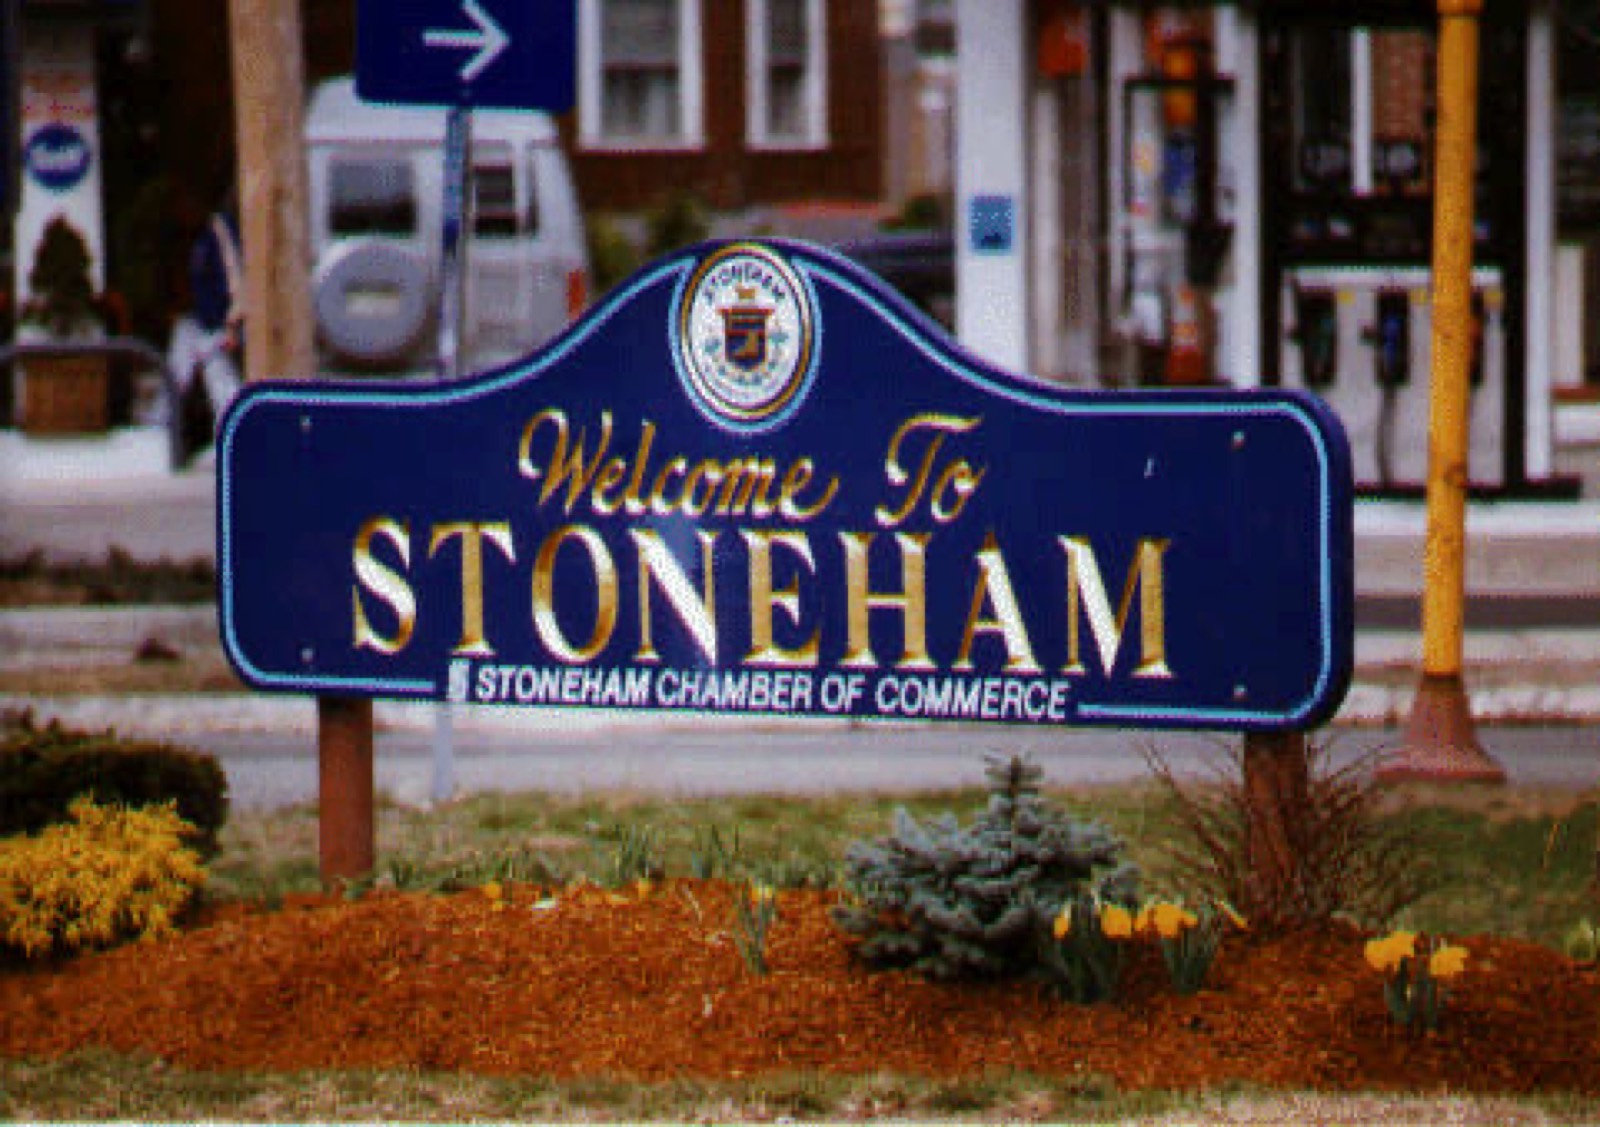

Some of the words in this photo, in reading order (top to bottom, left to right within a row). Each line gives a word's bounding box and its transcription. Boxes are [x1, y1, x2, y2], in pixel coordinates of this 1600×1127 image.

[518, 407, 839, 519] Welcome
[874, 412, 986, 527] To
[351, 516, 1172, 680] STONEHAM
[475, 663, 650, 706] STONEHAM
[654, 666, 813, 714] CHAMBER
[820, 673, 866, 714] OF
[874, 674, 1071, 722] COMMERCE
